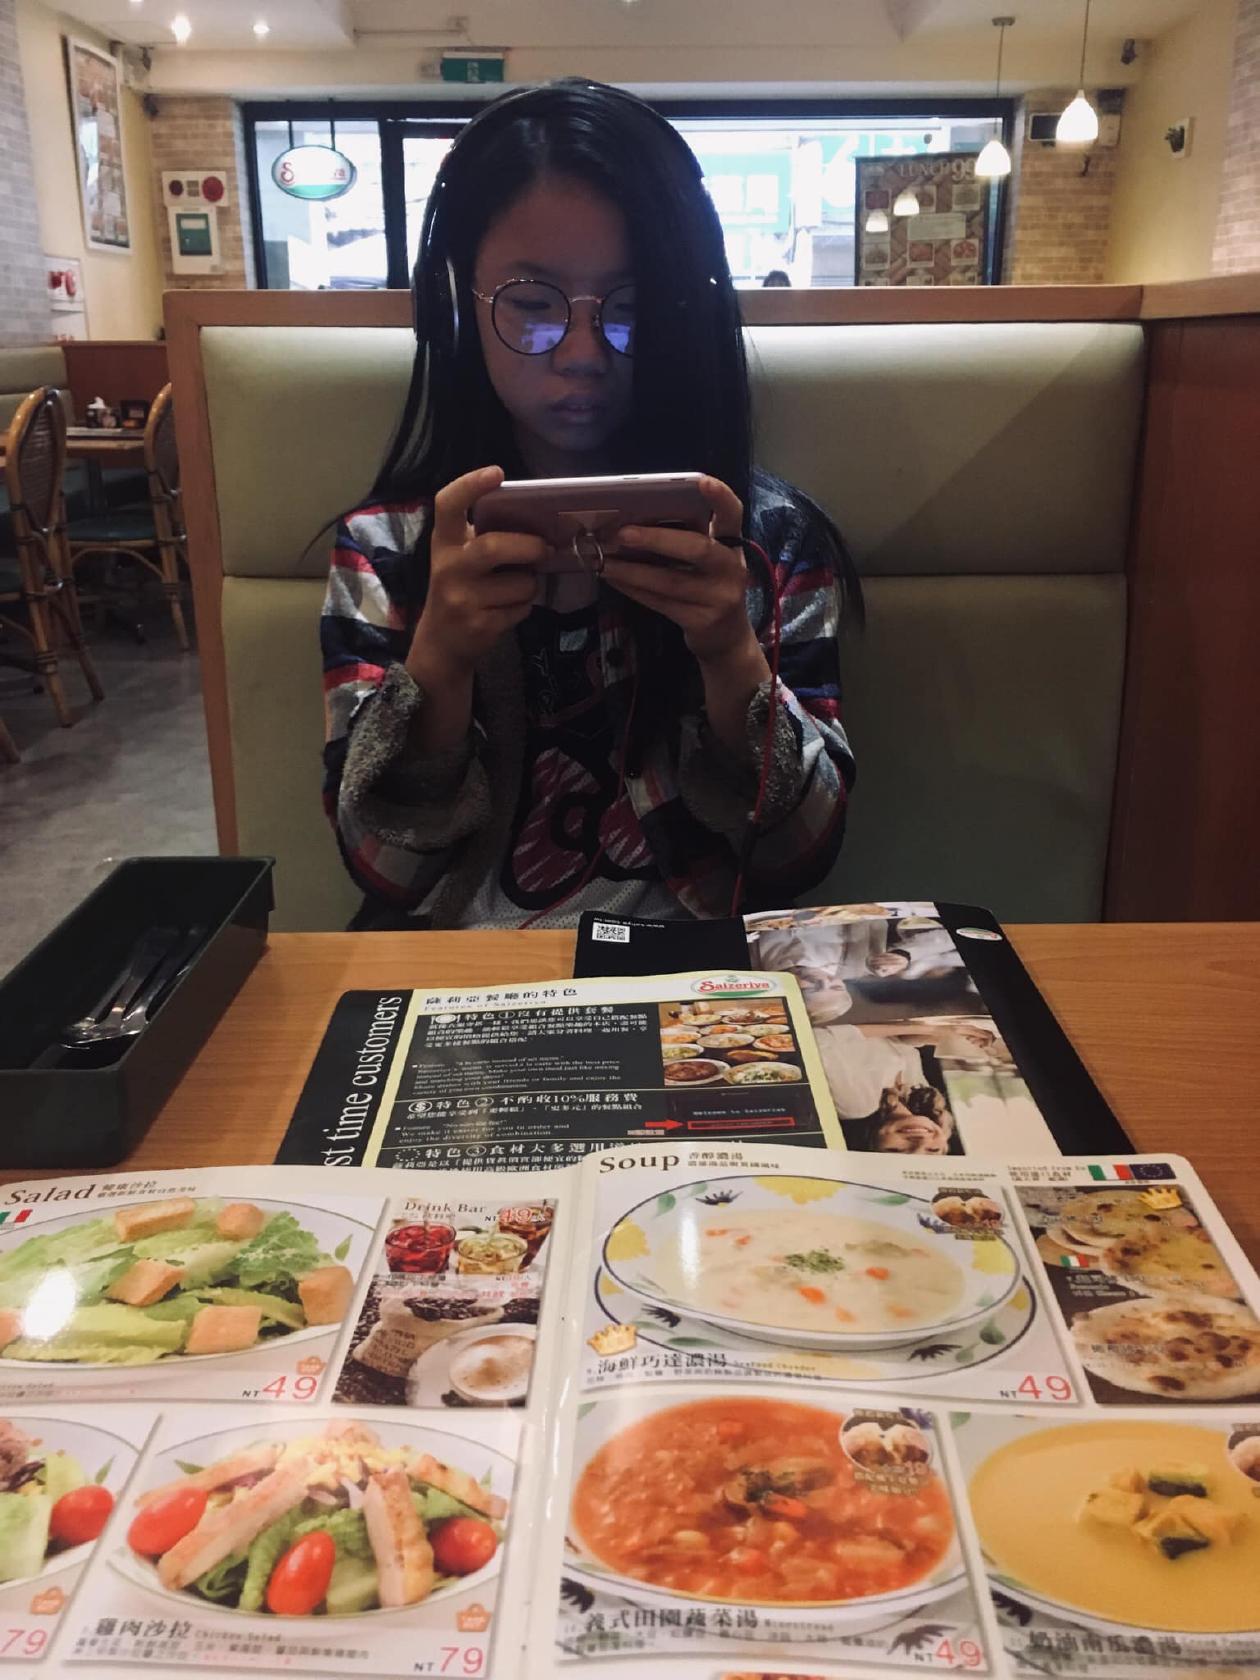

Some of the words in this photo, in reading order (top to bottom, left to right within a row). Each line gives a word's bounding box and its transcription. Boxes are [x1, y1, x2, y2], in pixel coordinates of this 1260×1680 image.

[352, 996, 402, 1086] customers
[323, 1092, 373, 1141] time
[321, 1146, 355, 1166] st
[599, 1155, 680, 1173] Soup
[5, 1184, 96, 1206] Salad
[404, 1201, 451, 1213] Drink
[458, 1203, 487, 1213] Bar
[598, 1353, 727, 1374] 海鮮巧達濃湯
[263, 1375, 318, 1400] 49
[1018, 1375, 1072, 1401] 49
[586, 1608, 758, 1632] 義式田園蔬菜湯
[1, 1628, 47, 1655] 79
[936, 1639, 981, 1667] 49
[440, 1647, 483, 1674] 79
